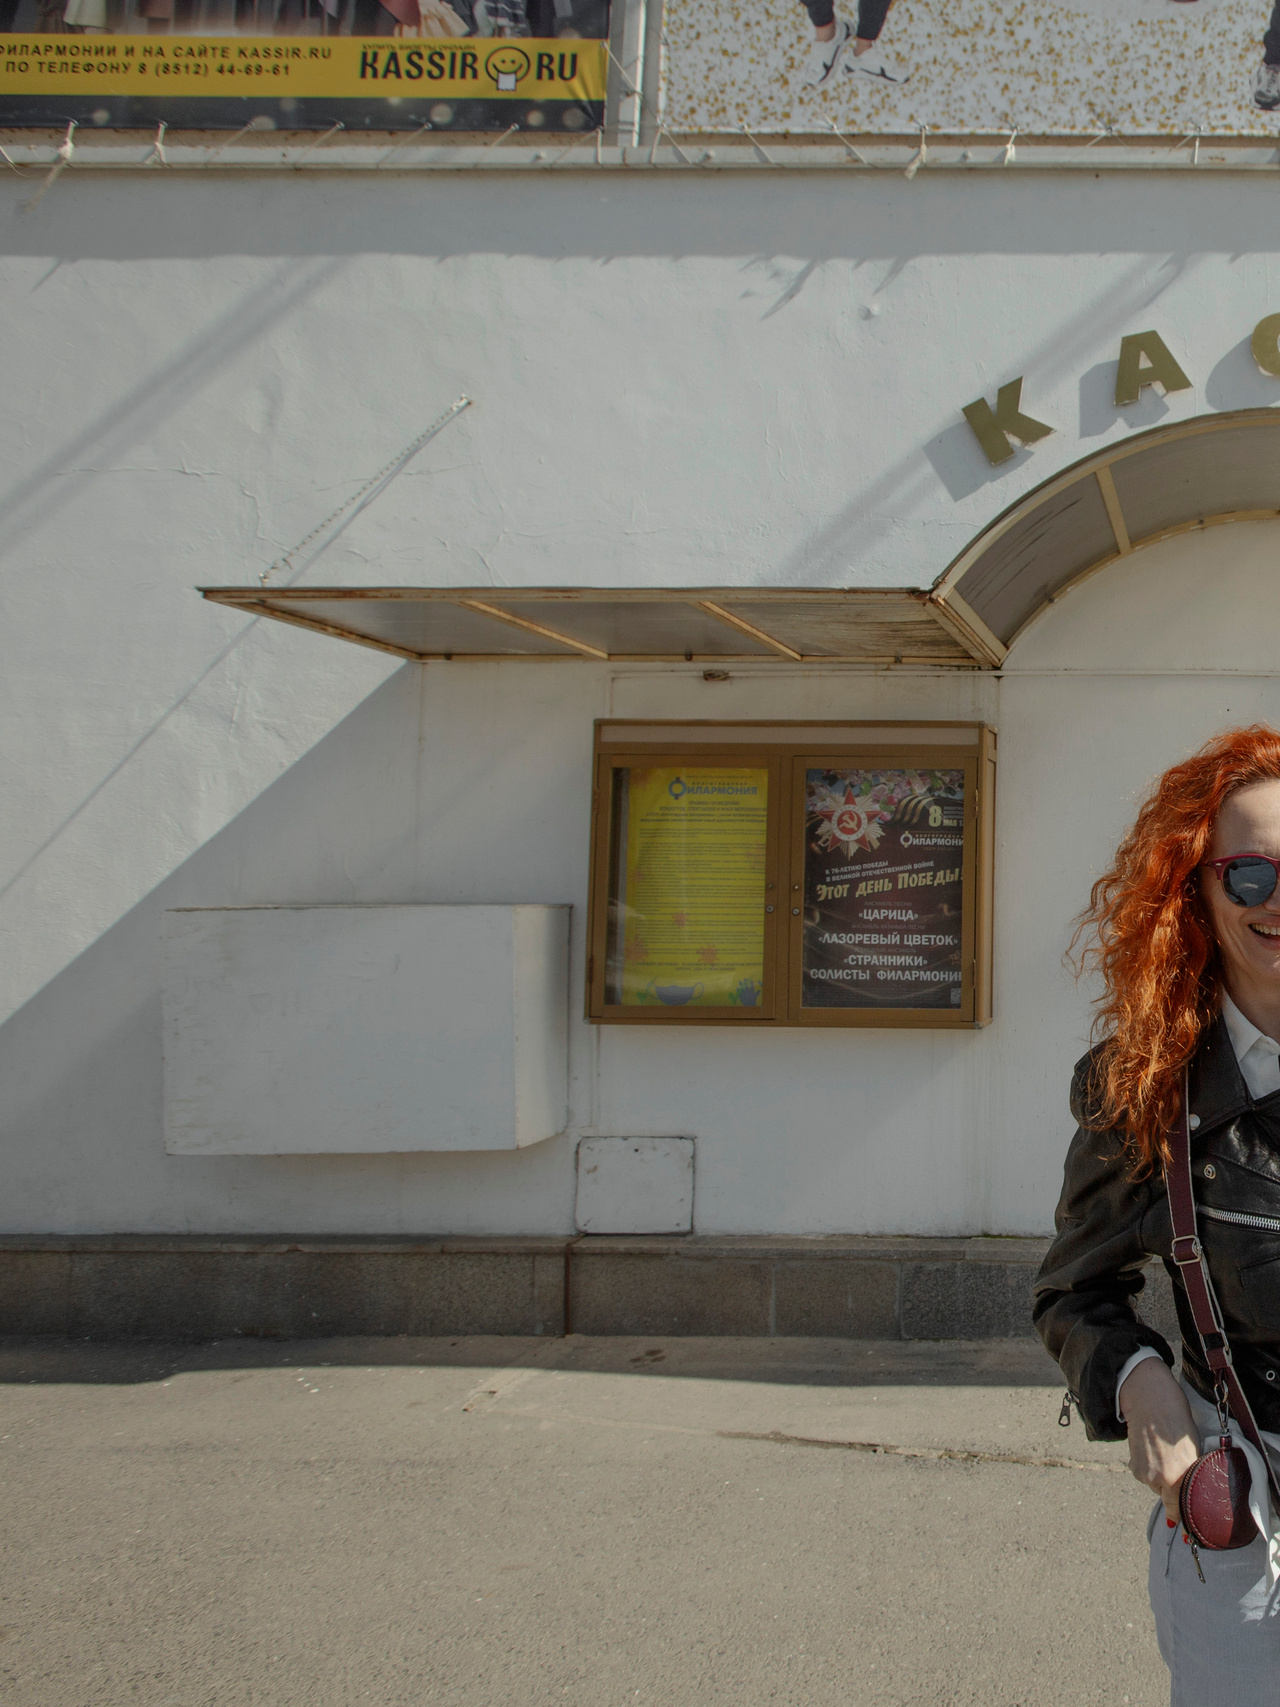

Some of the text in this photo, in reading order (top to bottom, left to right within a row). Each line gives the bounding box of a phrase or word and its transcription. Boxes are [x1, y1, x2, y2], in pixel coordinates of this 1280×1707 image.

[124, 45, 135, 57] И
[143, 46, 164, 58] НА
[173, 43, 230, 58] САЙТЕ
[237, 46, 332, 60] KASSIR.RU
[6, 61, 290, 78] ПО ТЕЛЕФОНУ 8 (8512) 44-69-61
[668, 776, 758, 800] ФИЛАРМОНИЯ
[929, 805, 942, 827] 8
[832, 871, 860, 882] ВЕЛИКОЙ
[861, 865, 912, 877] ОТЕЧЕСТВЕННОЙ
[913, 860, 935, 870] ВОЙНЕ
[862, 860, 889, 869] ПОБЕДЫ
[858, 909, 919, 922] «ЦАРИЦА»
[818, 931, 958, 947] «ЛАЗОРЕВЫЙ ЦВЕТОК»
[843, 955, 928, 966] «СТРАННИКИ»
[810, 968, 870, 980] СОЛИСТЫ
